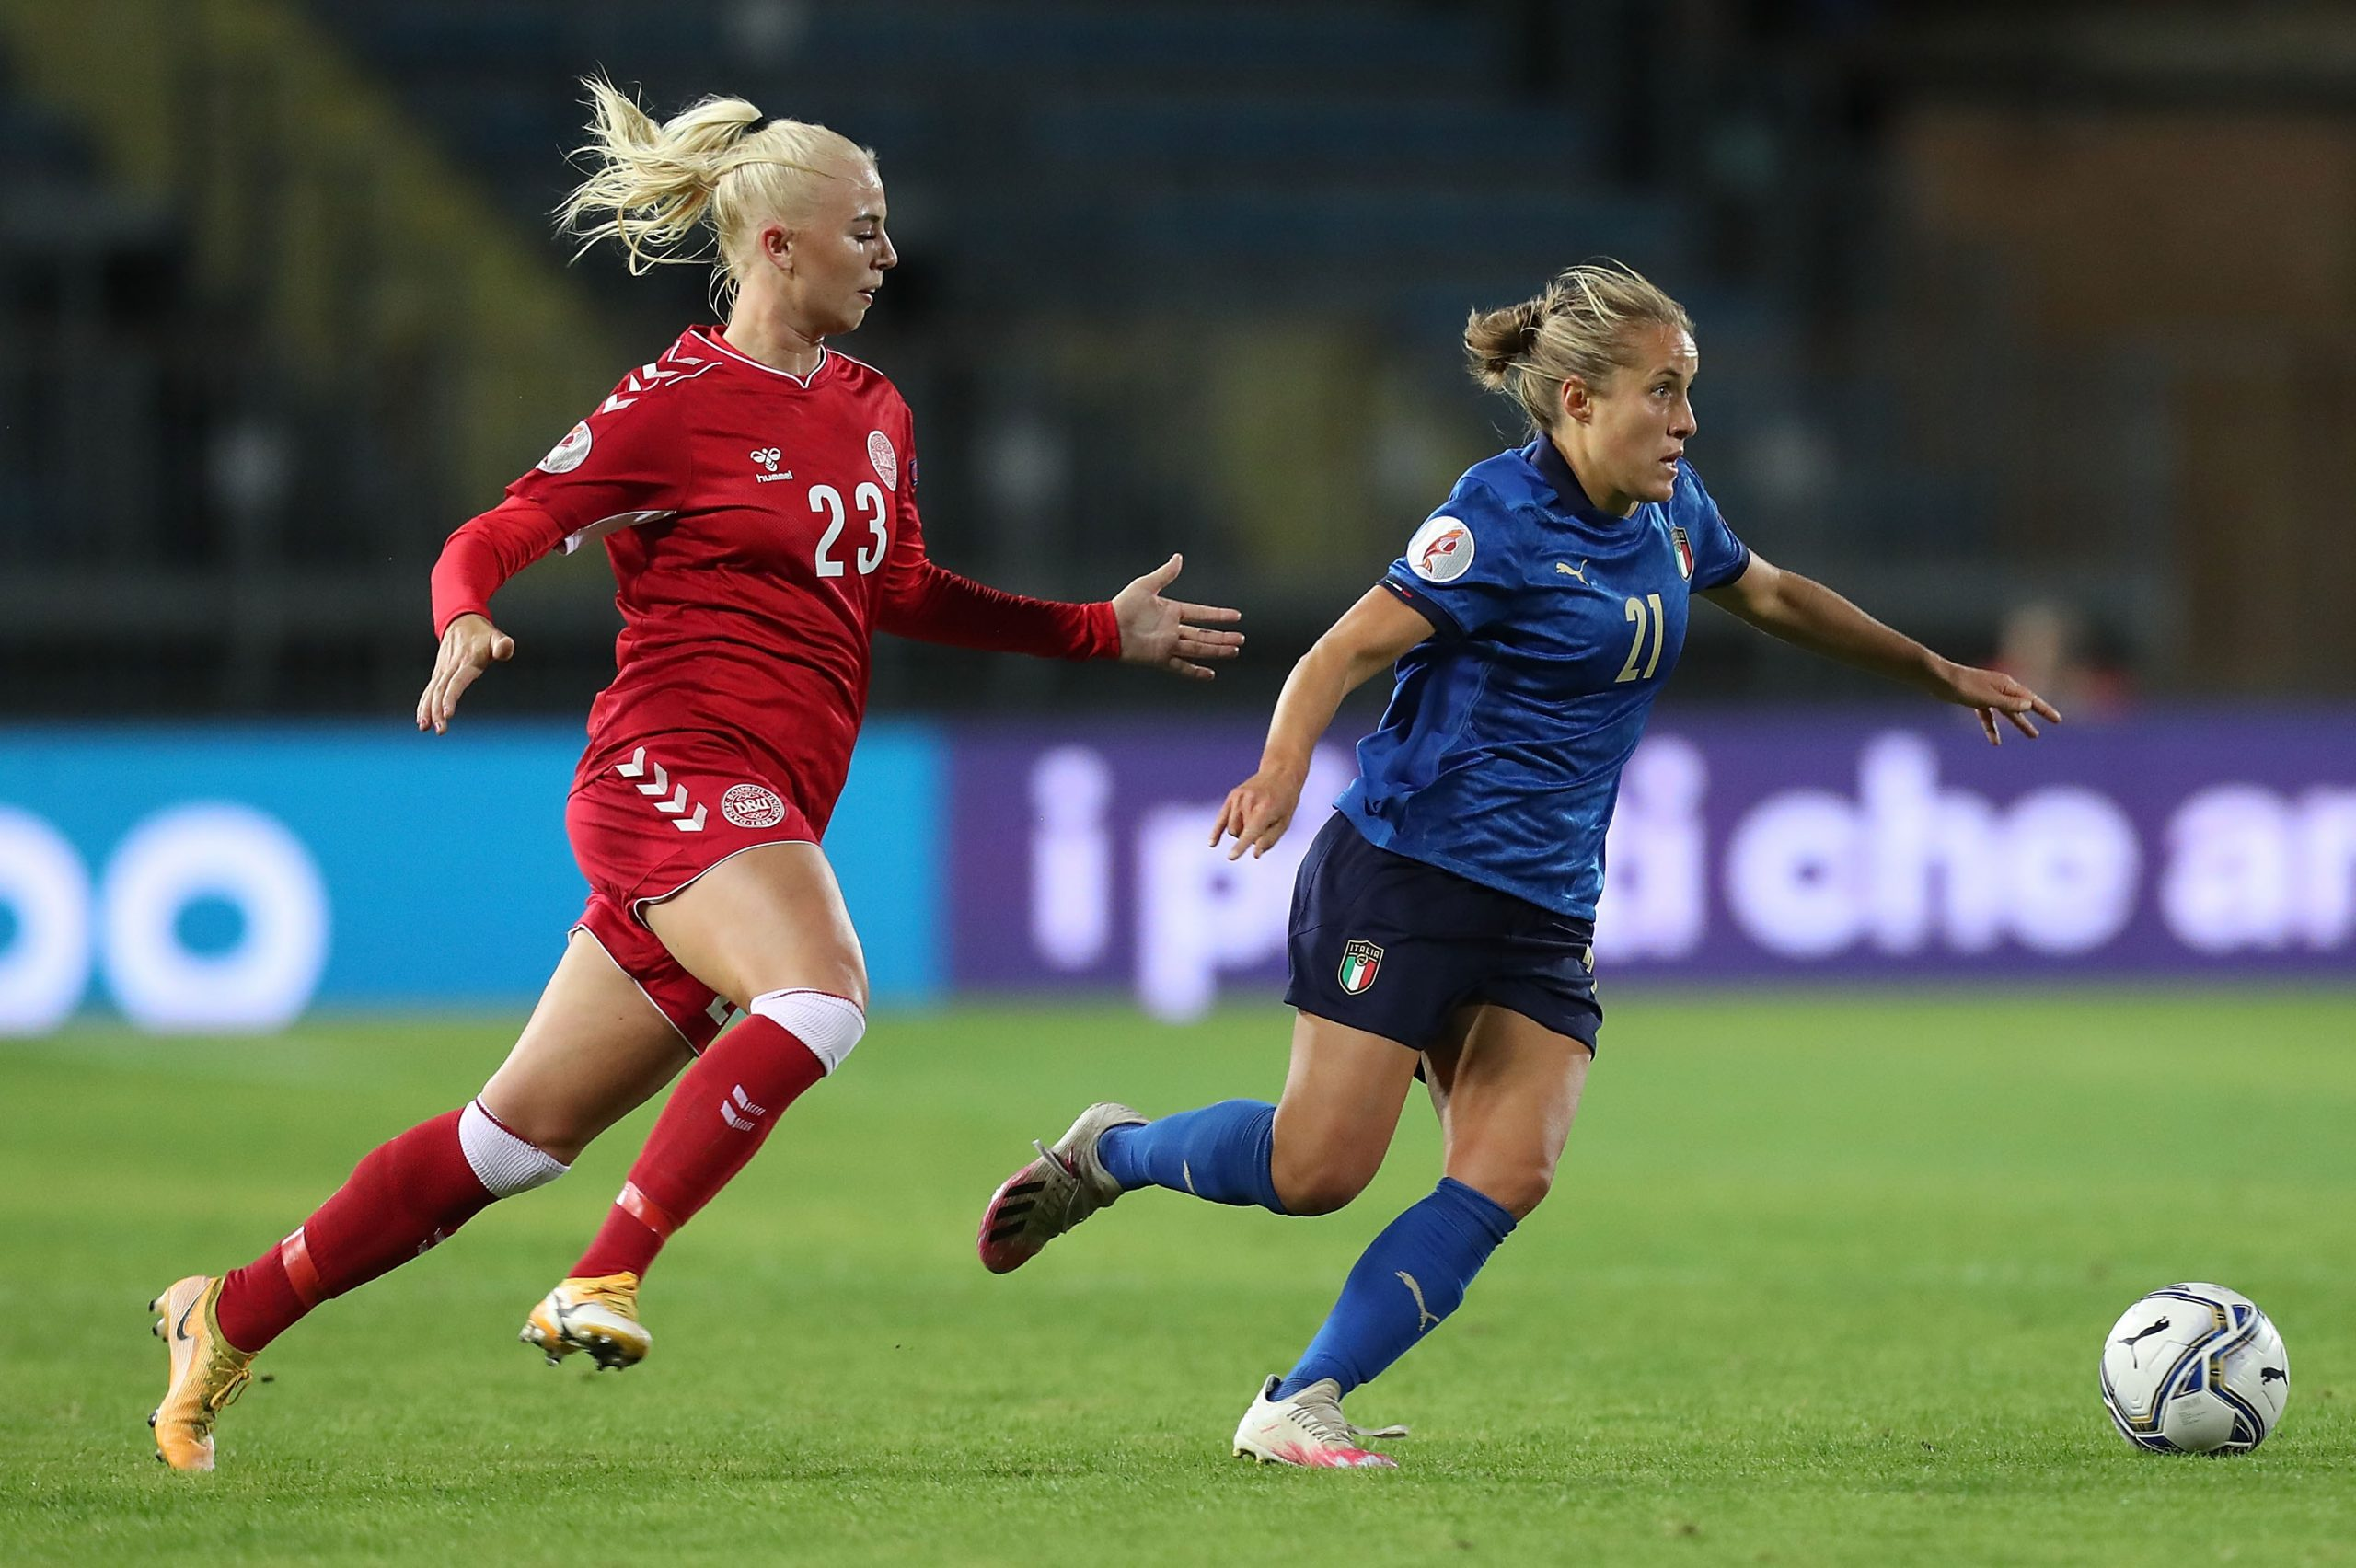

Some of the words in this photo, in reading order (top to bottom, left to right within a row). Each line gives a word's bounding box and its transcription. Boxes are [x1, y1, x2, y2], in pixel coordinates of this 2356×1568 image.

[756, 470, 793, 483] hummel
[808, 482, 887, 577] 23
[1615, 594, 1664, 682] 21
[733, 797, 771, 814] DBU
[1350, 944, 1380, 958] ITALIA
